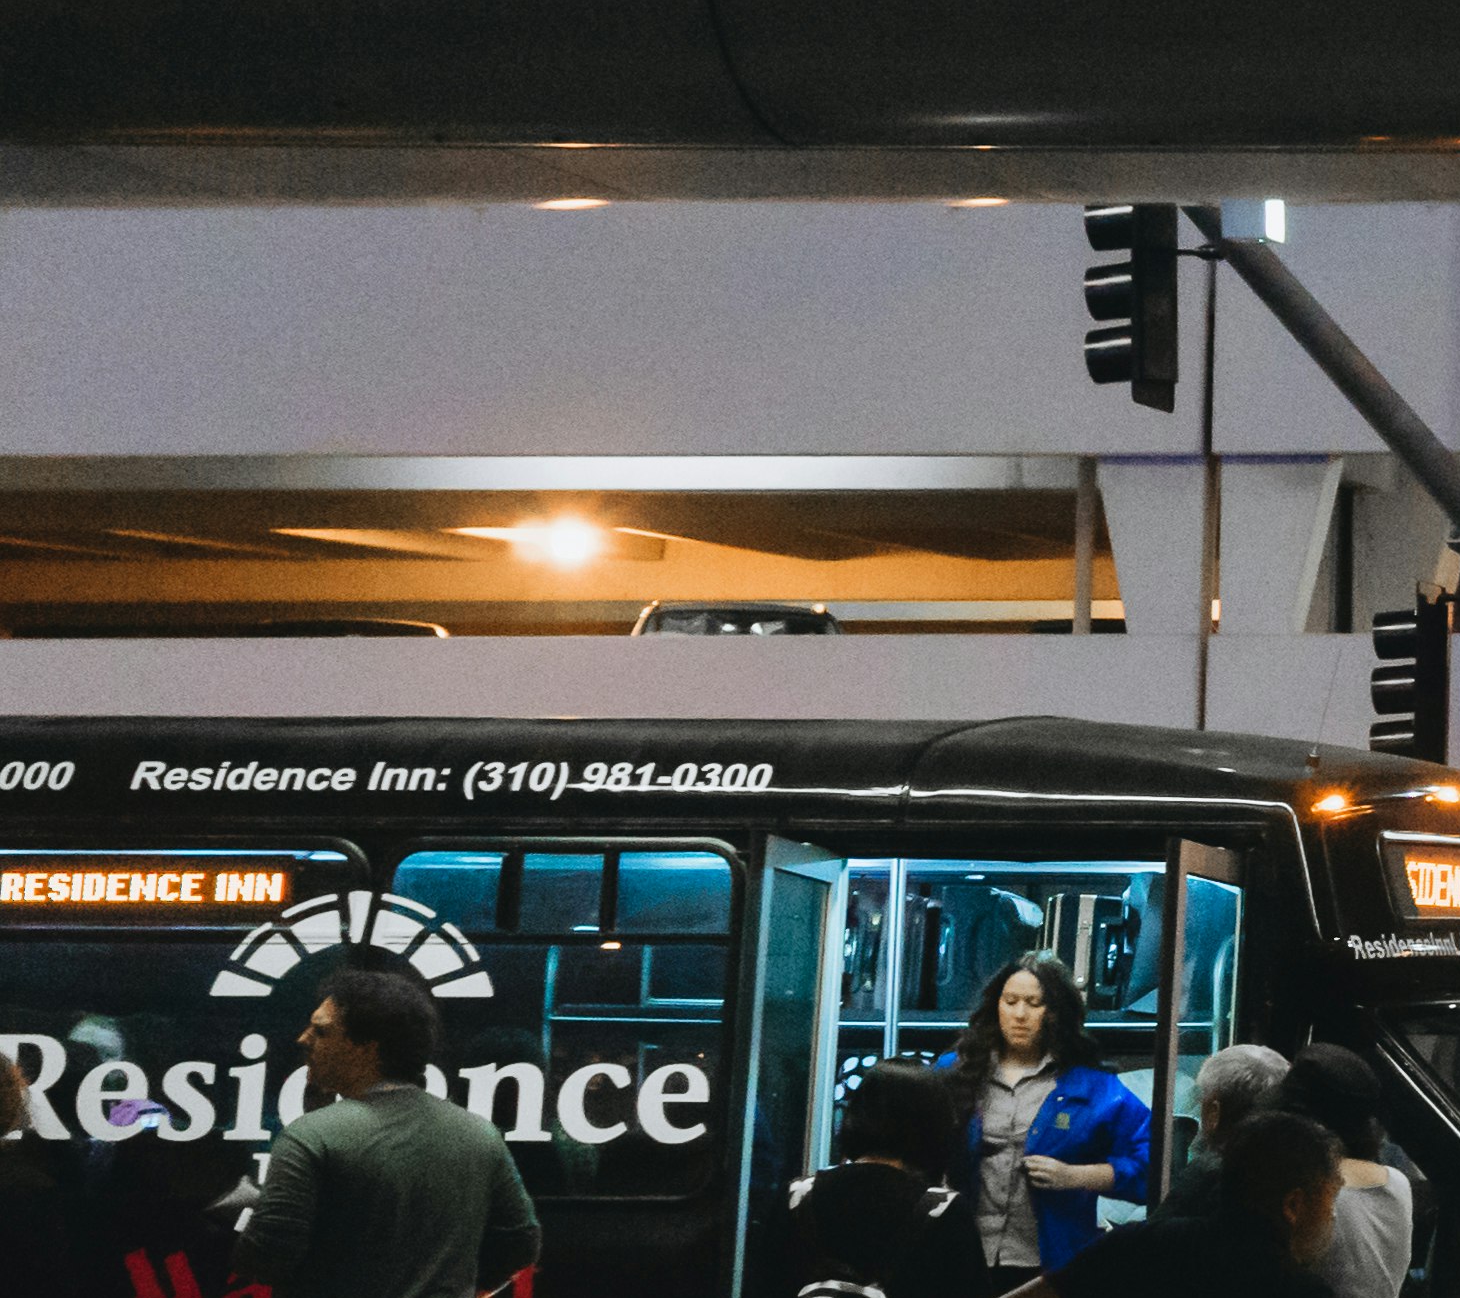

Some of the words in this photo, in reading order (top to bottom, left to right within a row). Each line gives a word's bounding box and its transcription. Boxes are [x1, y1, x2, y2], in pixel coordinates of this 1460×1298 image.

[129, 760, 357, 791] Residence
[367, 762, 452, 792] Inn:
[463, 761, 569, 801] (310)
[582, 762, 774, 793] 981-0300
[0, 872, 206, 903] RESIDENCE
[214, 872, 283, 903] INN
[0, 1033, 711, 1144] Resince
